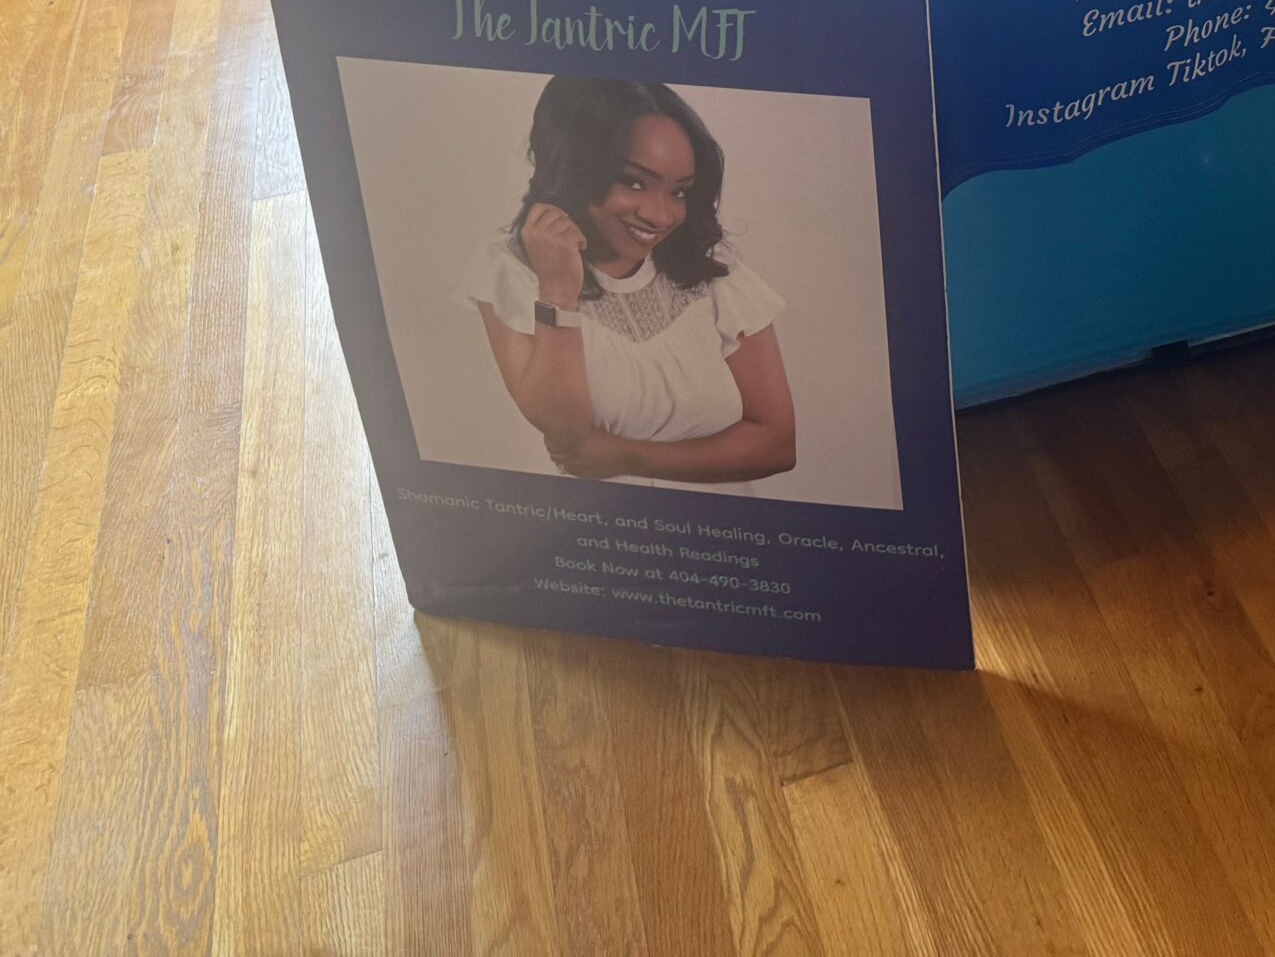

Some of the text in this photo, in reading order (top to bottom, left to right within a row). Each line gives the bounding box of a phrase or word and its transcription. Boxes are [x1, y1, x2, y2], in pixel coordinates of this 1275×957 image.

[671, 4, 757, 61] MFT
[1164, 4, 1252, 51] Phone:
[1005, 74, 1155, 128] Instagram
[1166, 34, 1247, 86] Tiktok,
[395, 487, 480, 510] Shamanic
[615, 516, 649, 530] and
[654, 519, 691, 535] Soul
[698, 524, 770, 545] Healing,
[778, 532, 843, 552] Oracle,
[851, 538, 945, 559] Ancestral,
[554, 556, 791, 595] Book Now at 404-490-3830
[576, 535, 760, 569] and Health Readings
[533, 577, 822, 622] Website: www.thetantricmft.com
